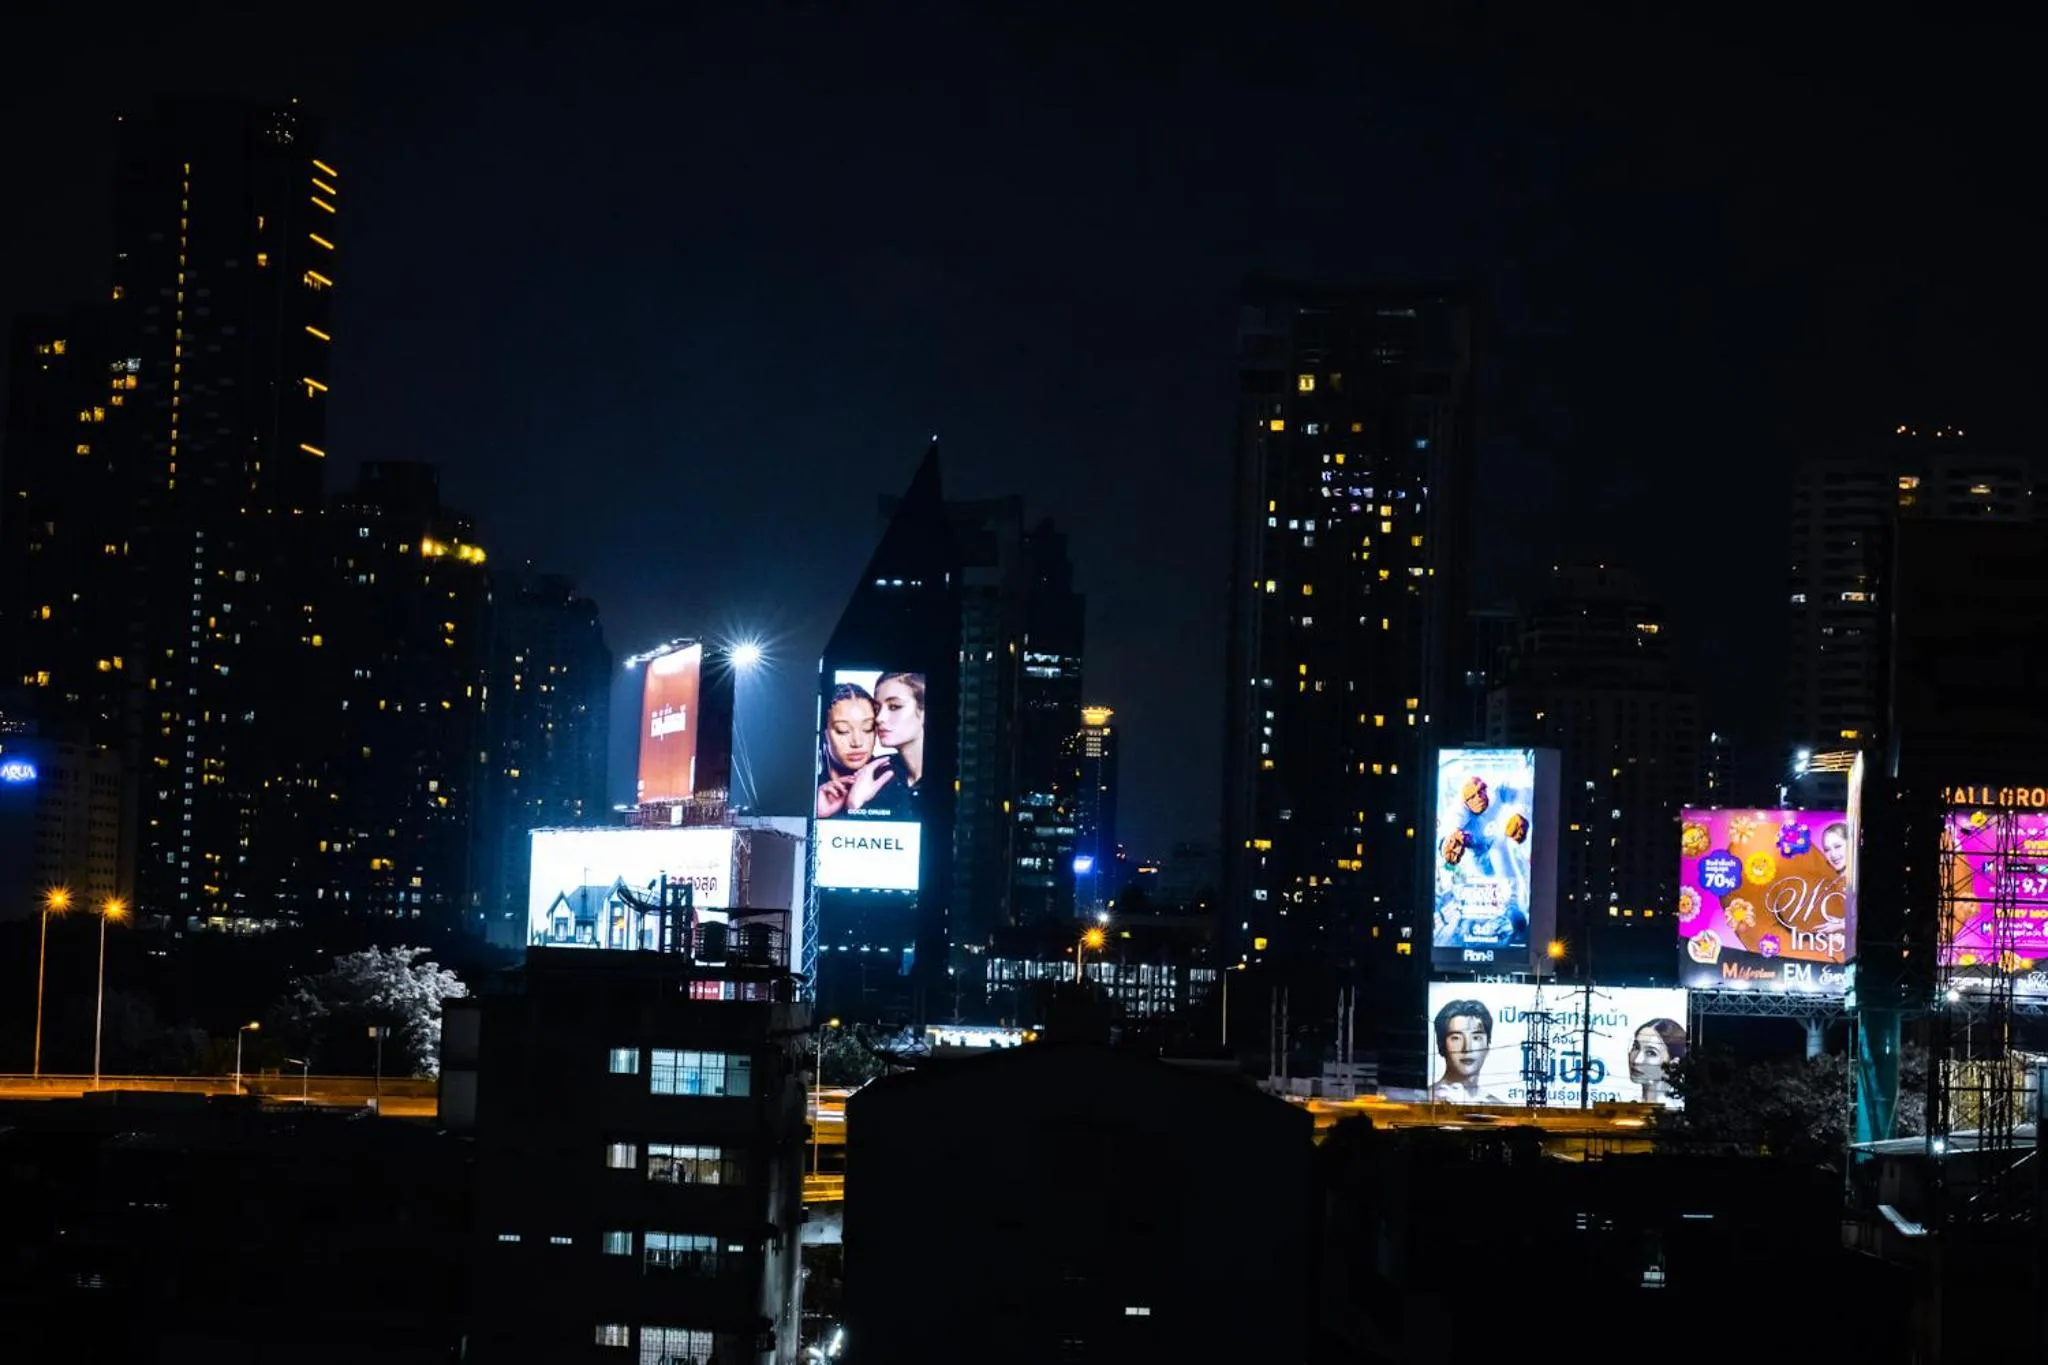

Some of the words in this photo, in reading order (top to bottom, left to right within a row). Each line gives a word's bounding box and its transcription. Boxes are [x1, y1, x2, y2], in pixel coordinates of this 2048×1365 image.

[1999, 788, 2048, 807] GRO
[831, 836, 904, 851] CHANEL
[1705, 873, 1736, 888] 70%
